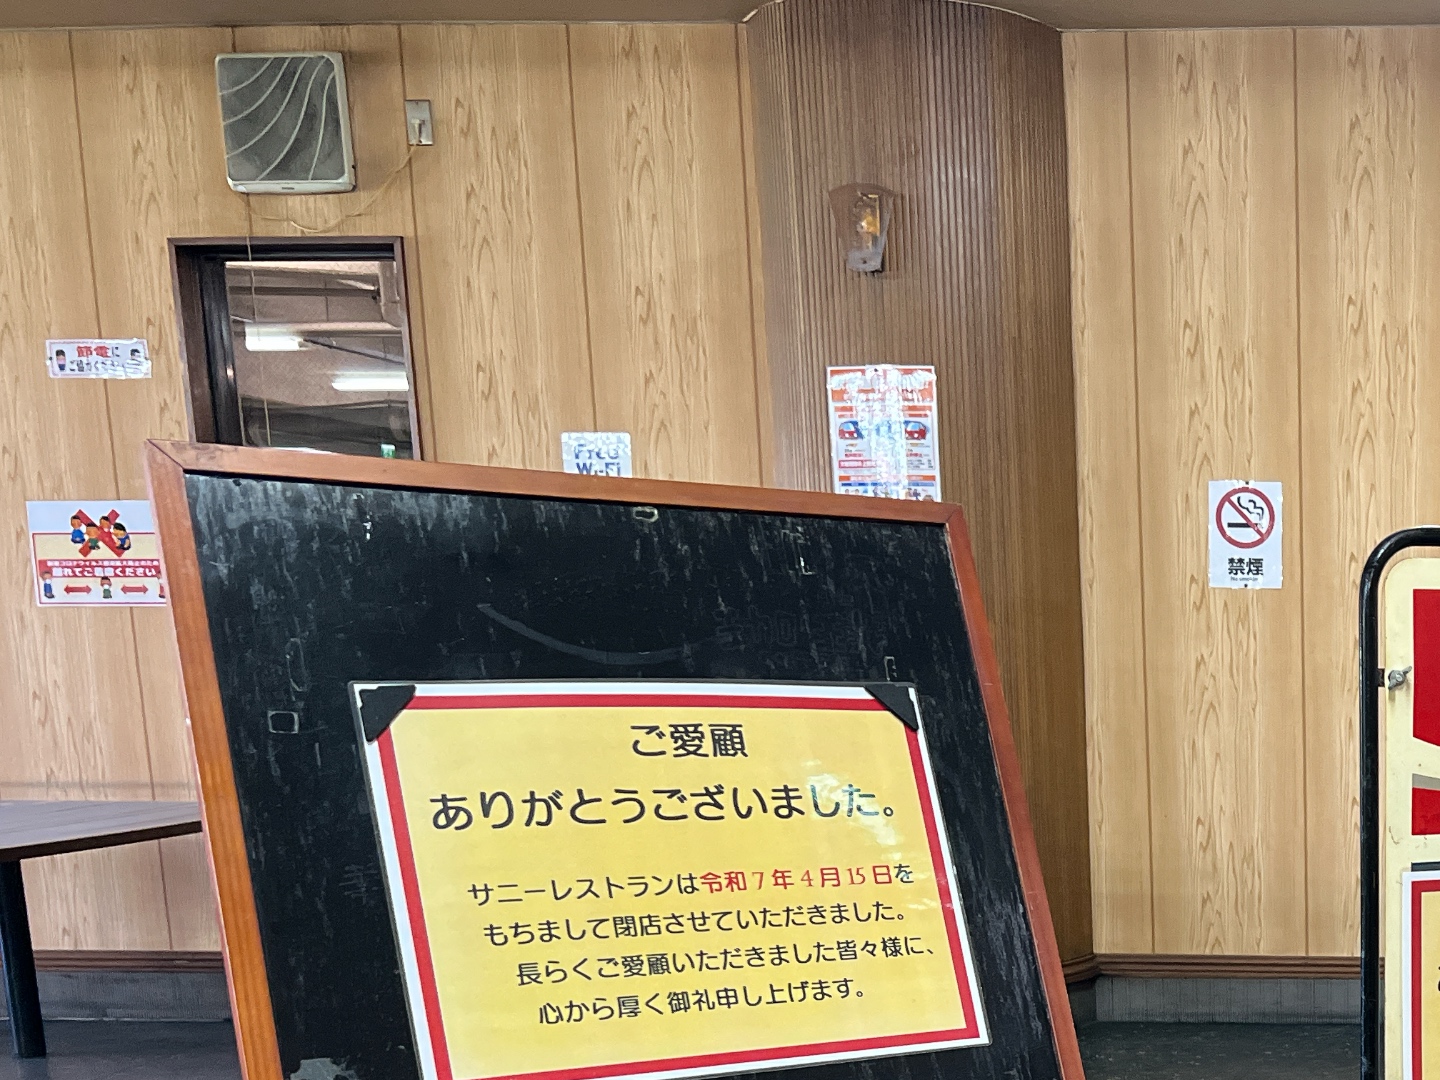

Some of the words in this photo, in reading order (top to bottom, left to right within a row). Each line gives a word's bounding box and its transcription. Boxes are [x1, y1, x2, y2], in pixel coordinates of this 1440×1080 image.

[1228, 557, 1264, 576] 禁煙
[630, 722, 748, 759] ご愛顧
[430, 782, 897, 831] ありがとうございました。
[483, 899, 907, 948] もちまして閉店させていただきました。
[516, 934, 938, 987] 長らくご愛顧いただきました皆々様に、
[538, 977, 867, 1026] 心から厚く御礼申し上げます。
